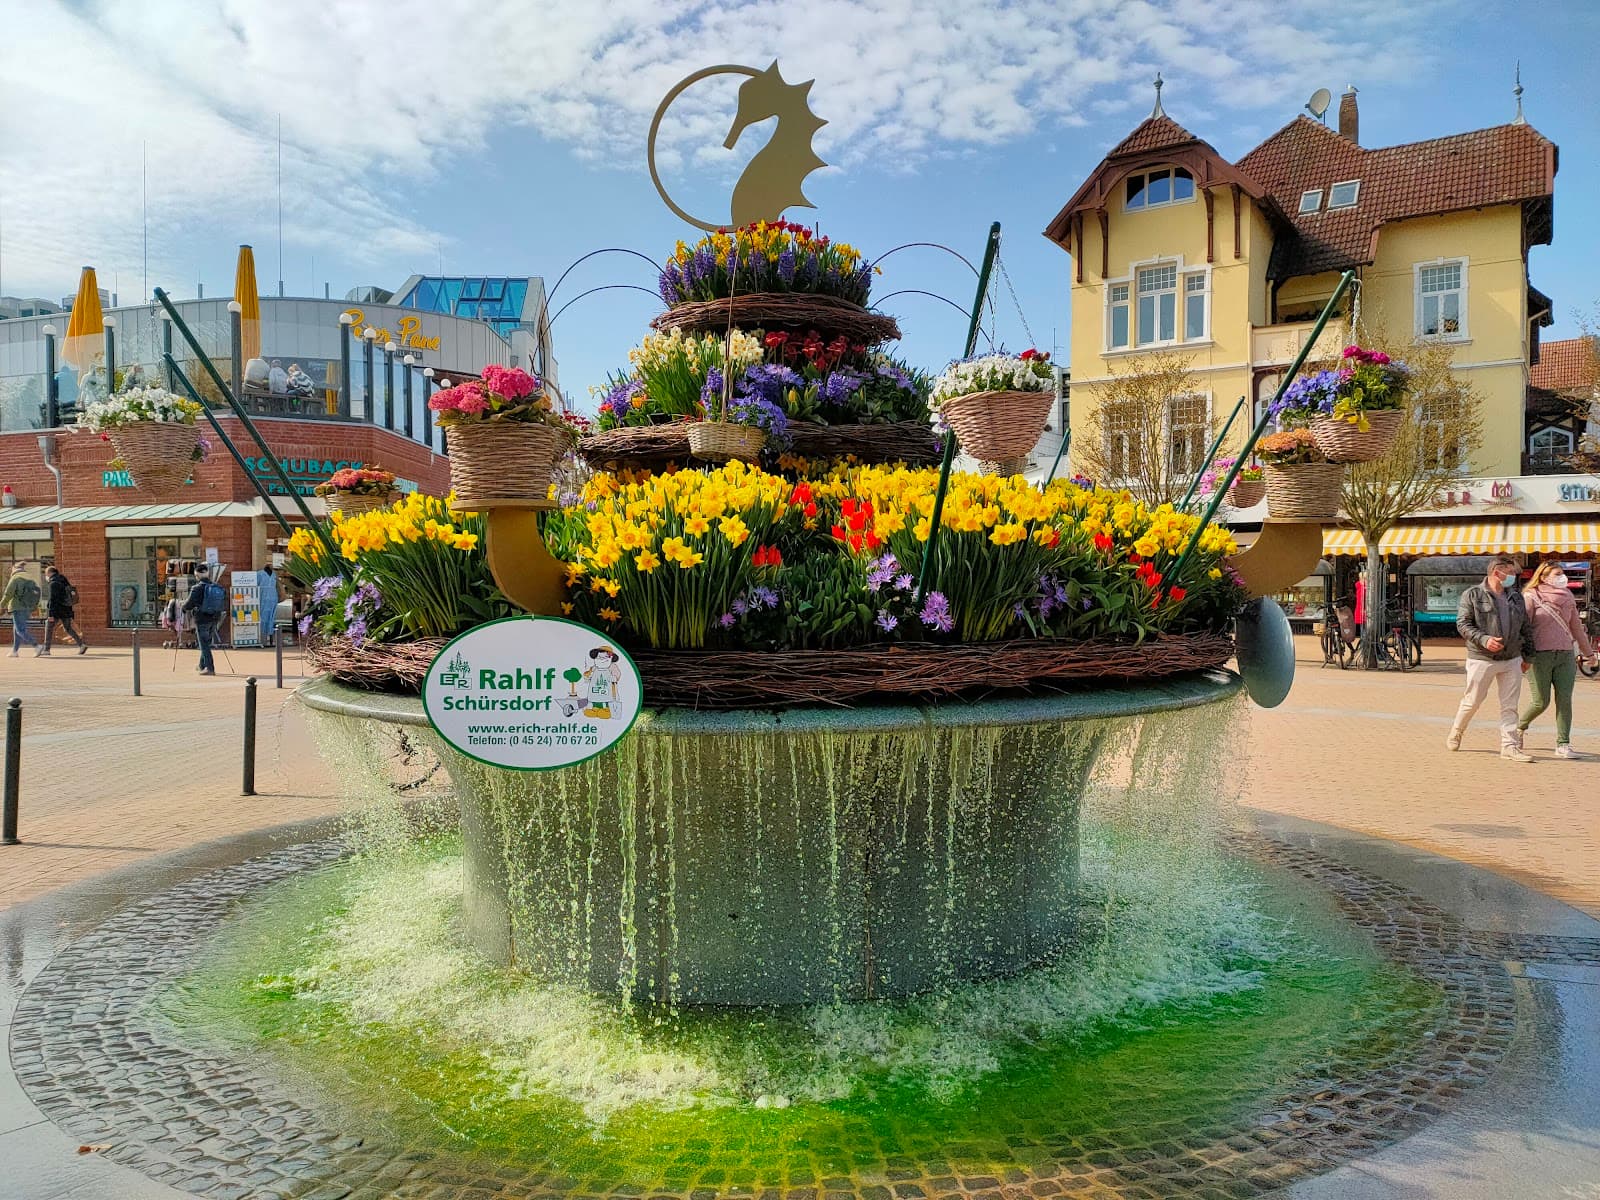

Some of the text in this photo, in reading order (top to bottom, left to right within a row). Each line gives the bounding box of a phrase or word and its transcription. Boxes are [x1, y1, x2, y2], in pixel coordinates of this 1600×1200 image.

[397, 316, 441, 351] Pane
[480, 667, 556, 690] Rahlf
[443, 695, 552, 711] Schürsdorf
[468, 723, 598, 734] www.erich-rahlf.de
[468, 735, 598, 747] Telefon: (0 45 24) 70 67 20
